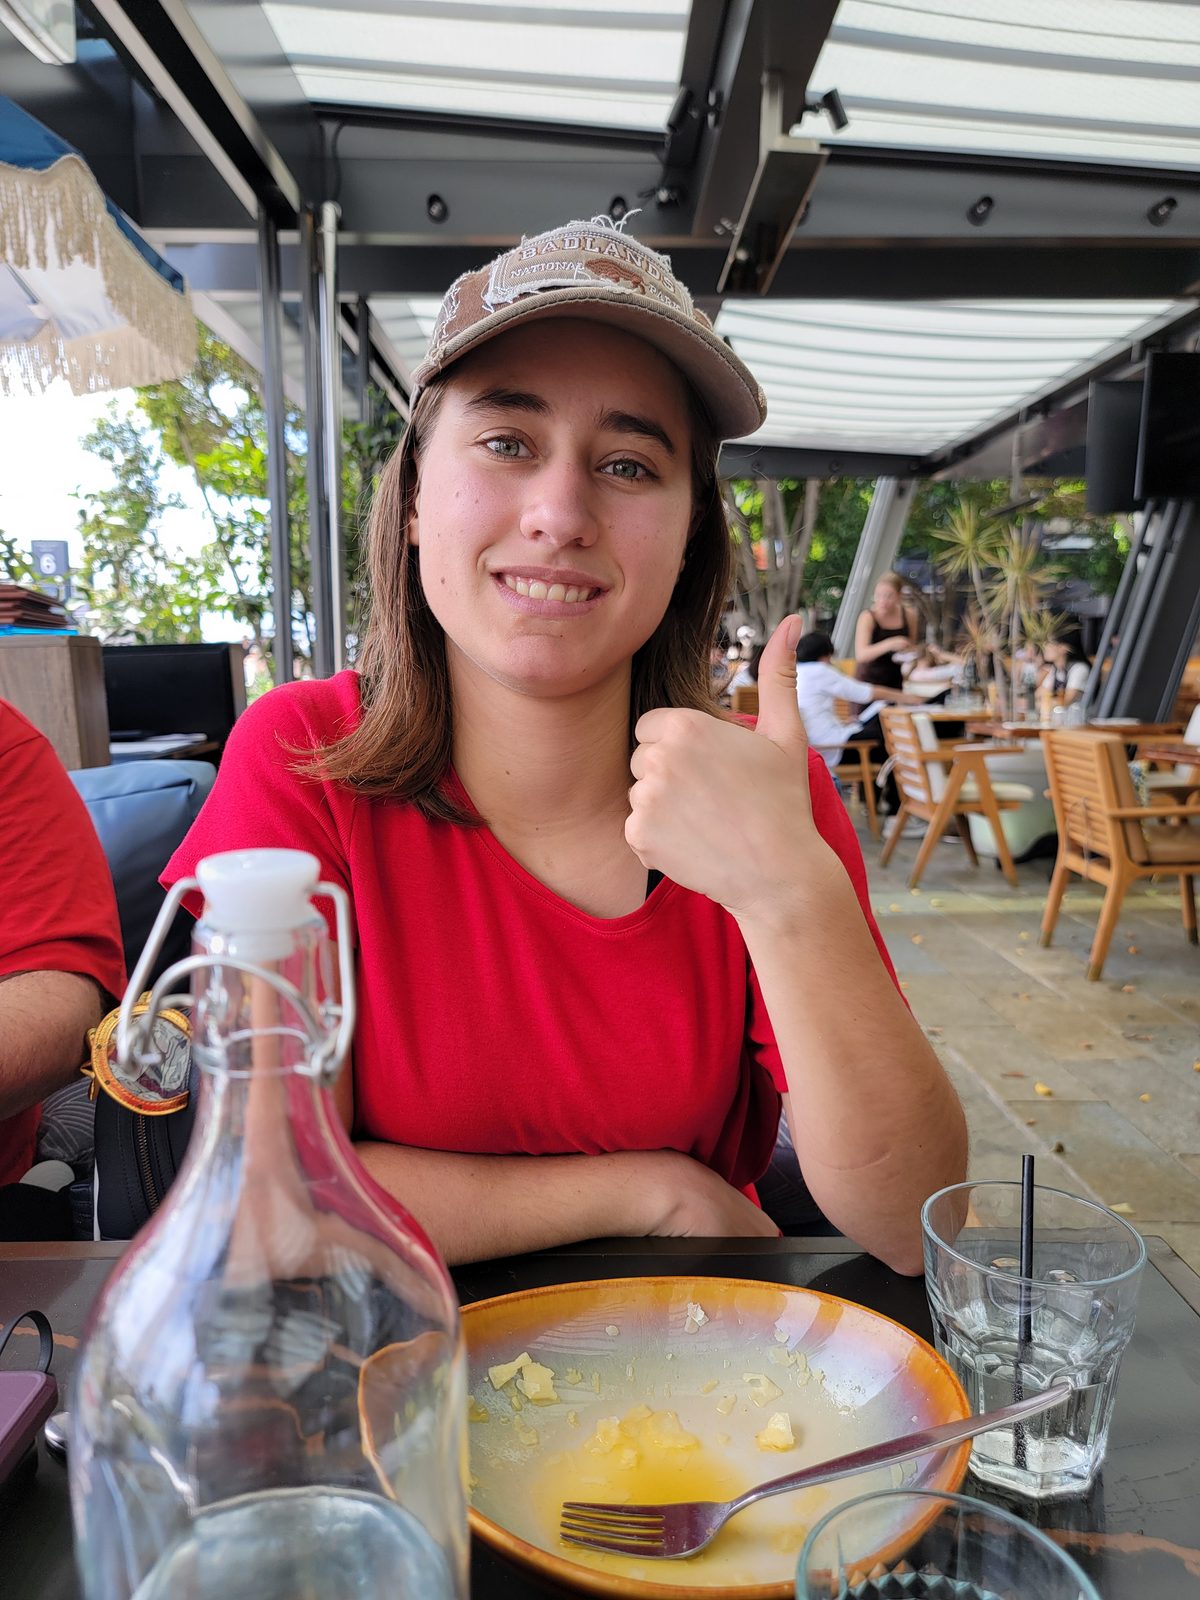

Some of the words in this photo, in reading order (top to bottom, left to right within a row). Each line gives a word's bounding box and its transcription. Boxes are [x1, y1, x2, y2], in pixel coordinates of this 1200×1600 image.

[510, 261, 585, 278] NATIONAL
[648, 284, 681, 311] PARK
[520, 236, 676, 293] BADLANDS
[40, 553, 56, 574] 6
